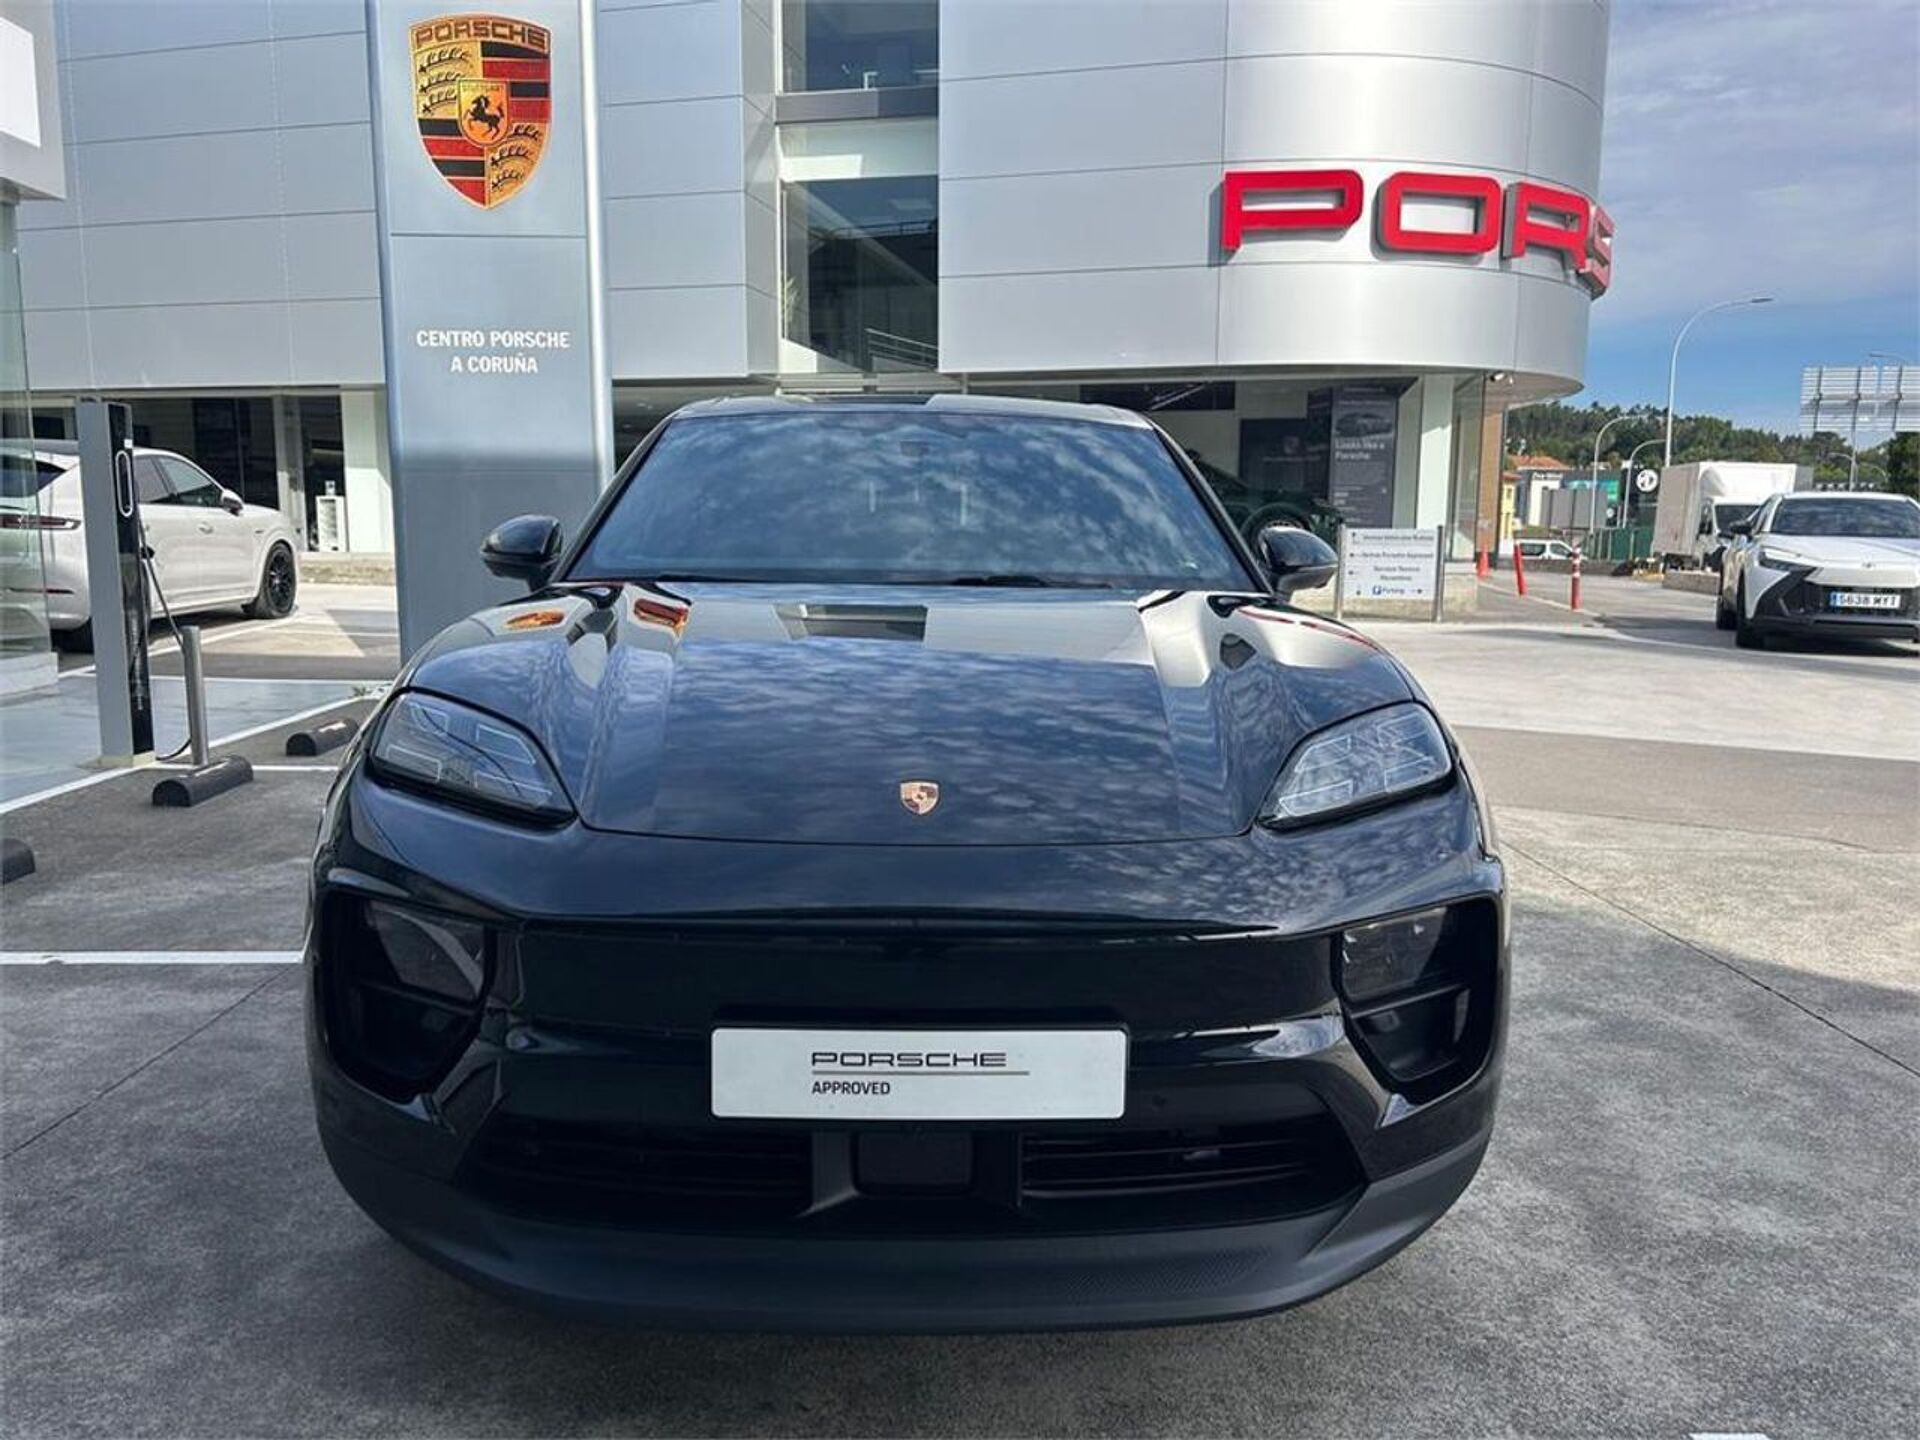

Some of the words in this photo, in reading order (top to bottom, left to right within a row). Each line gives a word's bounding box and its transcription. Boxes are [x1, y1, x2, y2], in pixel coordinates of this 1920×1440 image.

[415, 20, 545, 50] PORSCHE
[416, 330, 485, 347] CENTRO
[490, 330, 571, 348] PORSCHE
[450, 356, 463, 373] A
[467, 353, 539, 373] CORUÑA
[811, 1052, 1007, 1067] PORSCHE
[811, 1081, 891, 1095] APPROVED
